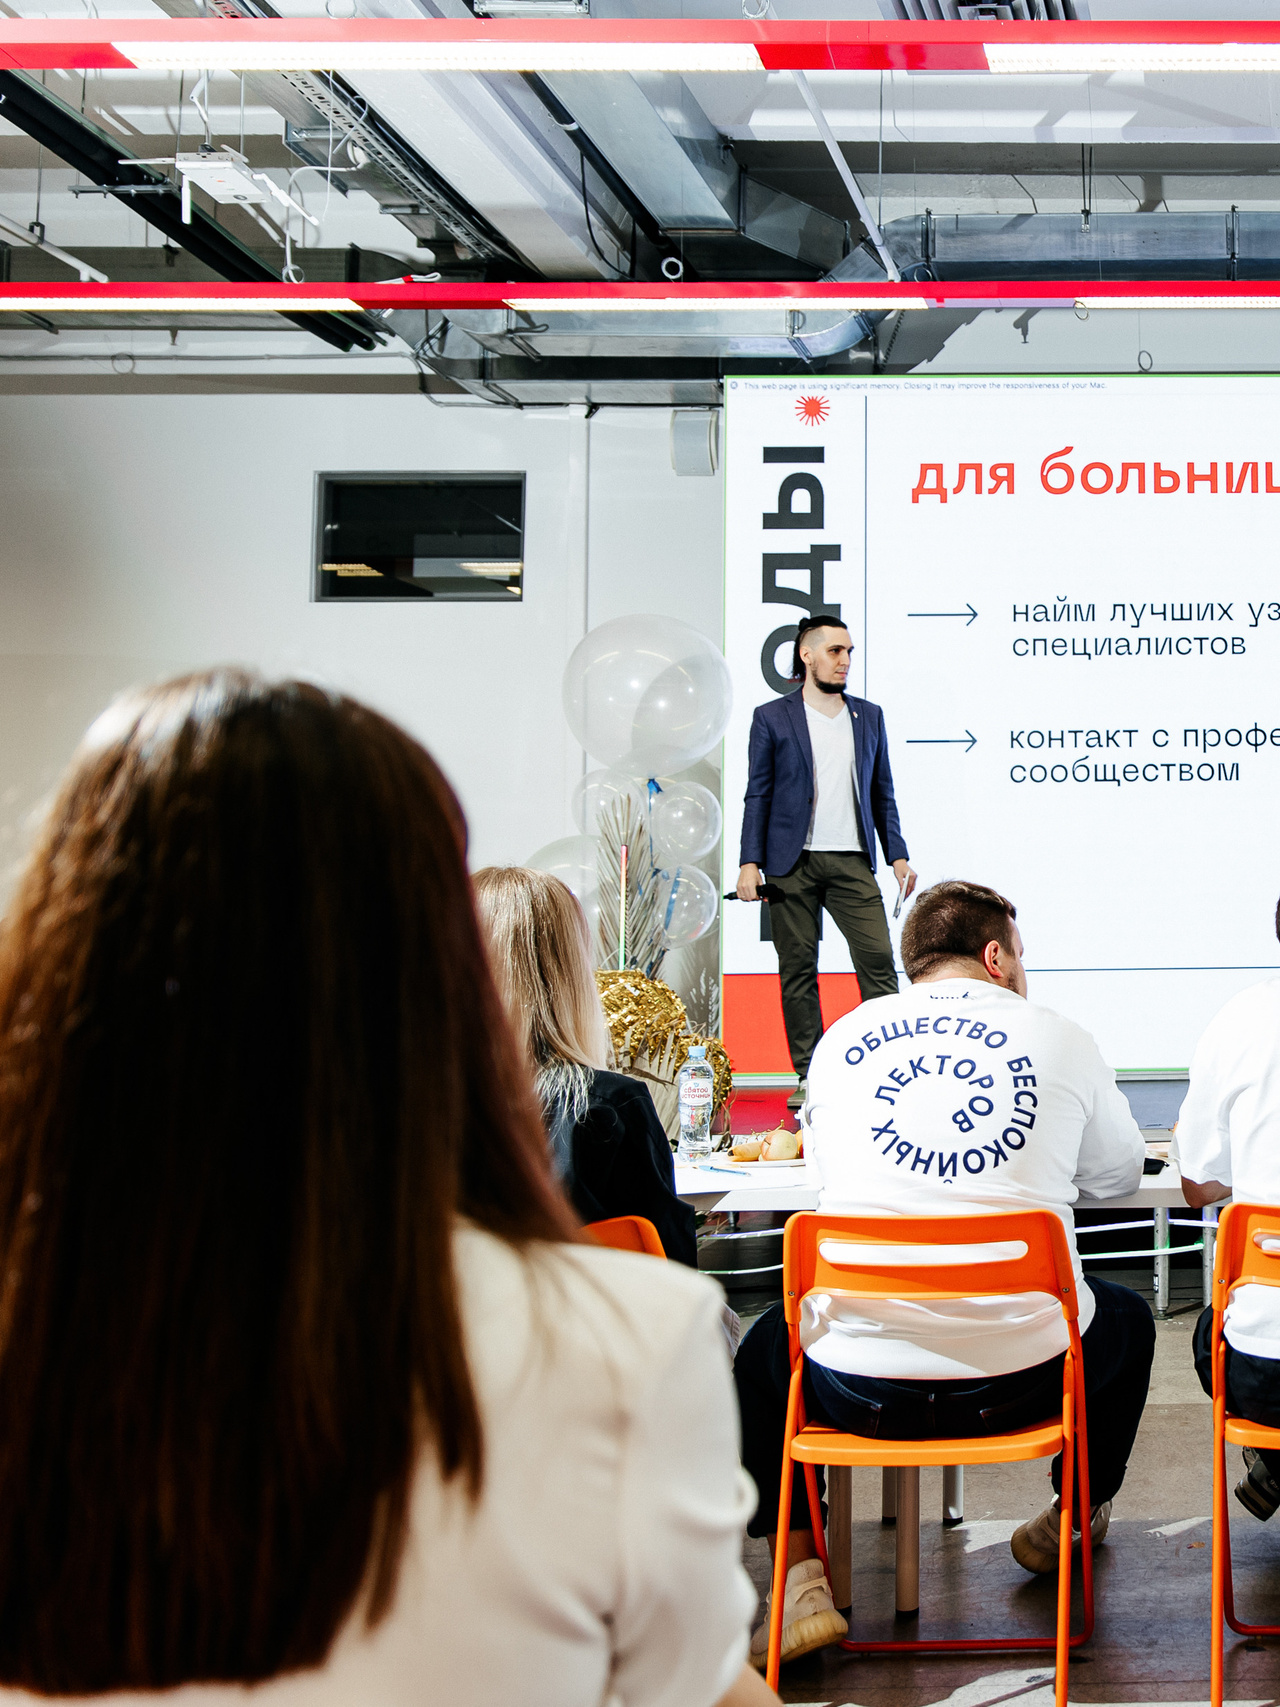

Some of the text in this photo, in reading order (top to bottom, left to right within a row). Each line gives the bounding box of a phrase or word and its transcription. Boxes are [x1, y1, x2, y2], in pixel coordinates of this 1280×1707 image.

[744, 382, 760, 390] This
[778, 383, 798, 392] page
[807, 383, 828, 392] using
[829, 382, 868, 392] significant
[903, 382, 932, 391] Closing
[933, 382, 939, 390] it
[940, 383, 956, 391] may
[957, 382, 987, 391] improve
[1003, 382, 1060, 391] responsiveness
[1061, 381, 1070, 389] of
[1071, 382, 1088, 391] your
[1089, 381, 1108, 389] Mac.
[911, 462, 1015, 504] для
[1012, 595, 1096, 623] найм
[1109, 602, 1234, 629] лучших
[1012, 636, 1247, 661] специалистов
[1010, 729, 1139, 749] контакт
[1152, 729, 1170, 748] с
[1009, 757, 1240, 788] сообществом
[845, 1016, 1038, 1185] ОБЩЕСТВО БЕСПОКОЙНЫХ ЛЕКТОРОВ
